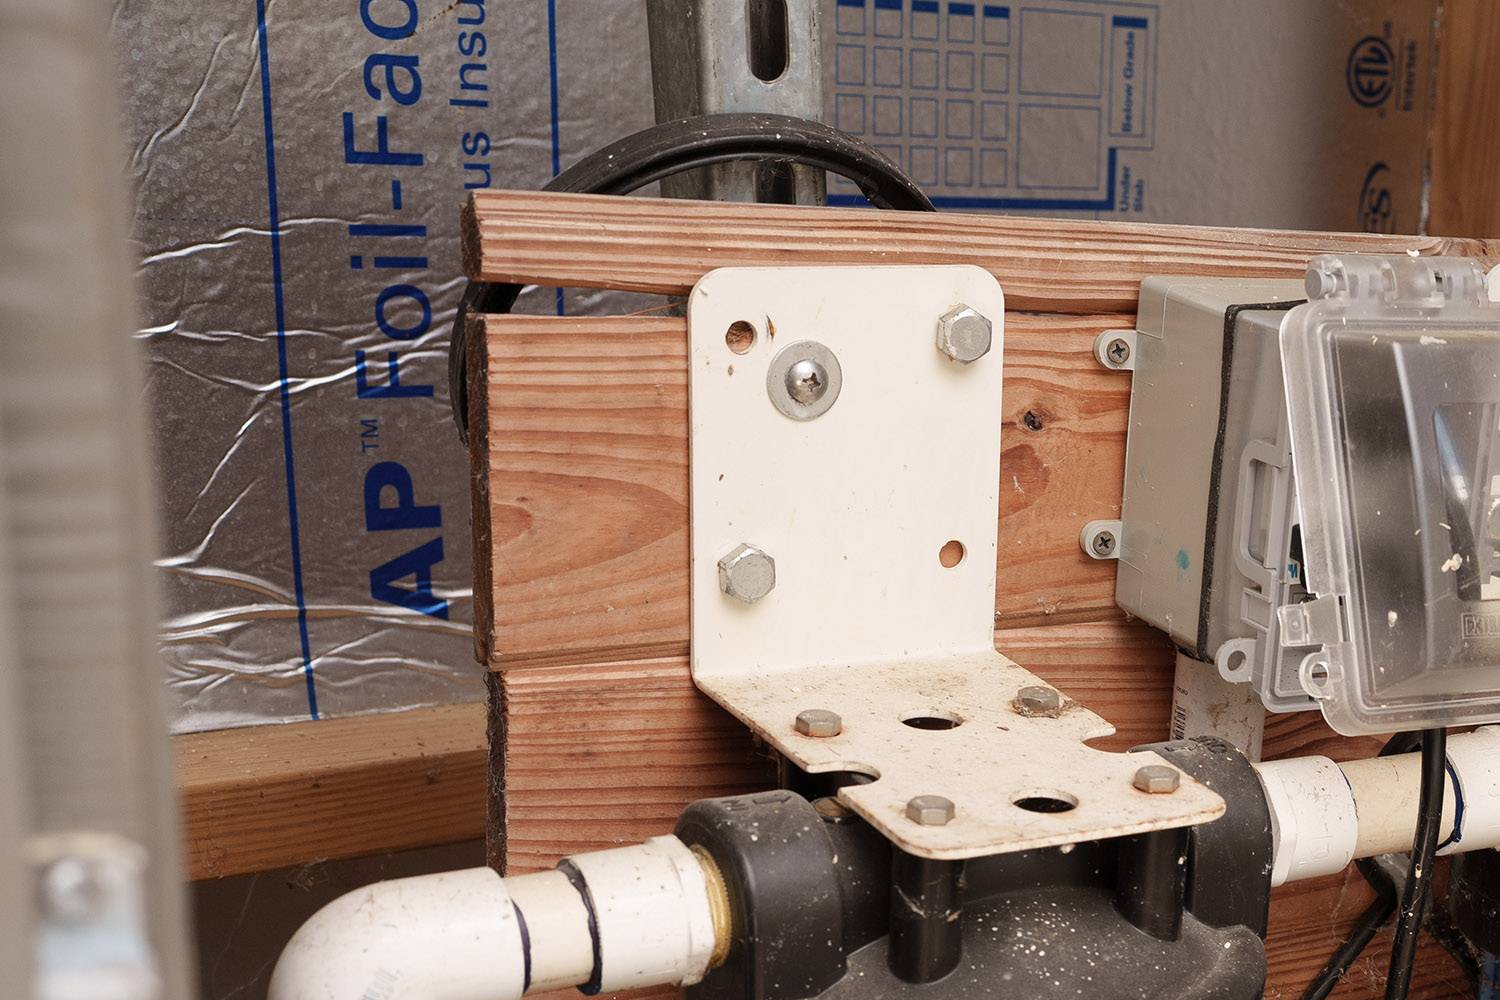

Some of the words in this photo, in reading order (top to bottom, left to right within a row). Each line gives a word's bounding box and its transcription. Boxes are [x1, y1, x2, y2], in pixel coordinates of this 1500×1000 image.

[1122, 31, 1136, 80] Grade
[1121, 84, 1133, 133] Below
[1119, 166, 1132, 213] Under
[1133, 178, 1145, 213] Slab
